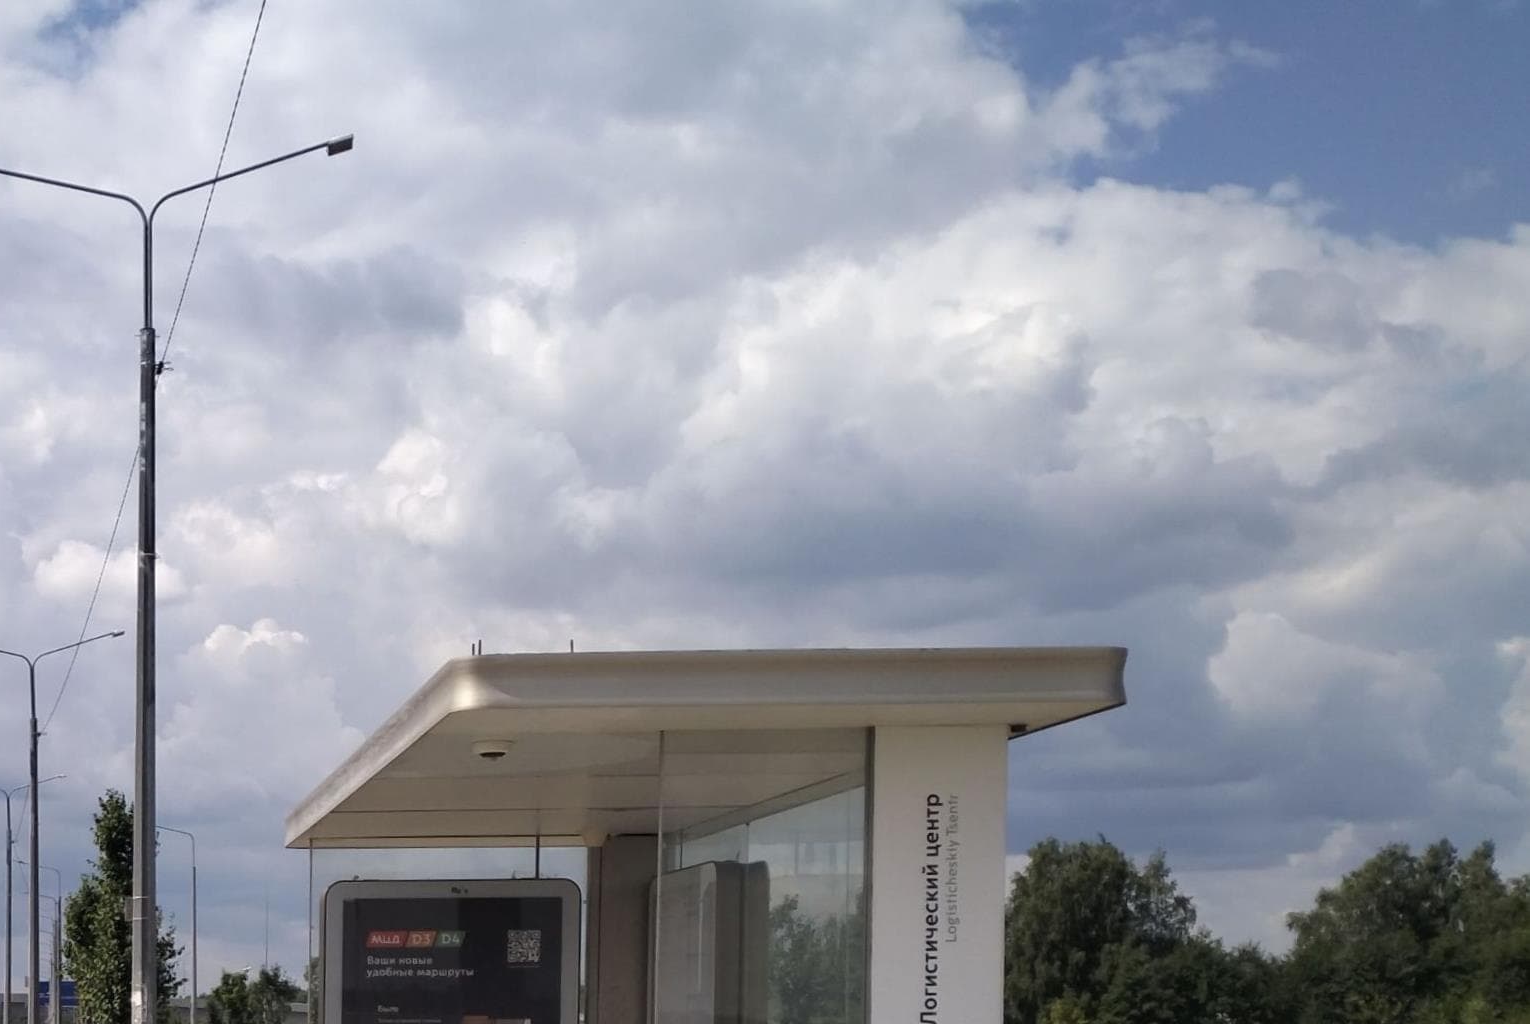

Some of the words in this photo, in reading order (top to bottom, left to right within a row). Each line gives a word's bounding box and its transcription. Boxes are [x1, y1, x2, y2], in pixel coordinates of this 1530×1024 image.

[926, 793, 943, 857] центр
[946, 793, 959, 836] Tsentr
[945, 842, 960, 942] Logisticheskiy
[413, 934, 431, 944] D3
[441, 934, 460, 944] D4
[366, 967, 414, 977] удобные
[416, 969, 475, 978] маршруты
[367, 956, 396, 966] Ваши
[399, 957, 433, 966] новые
